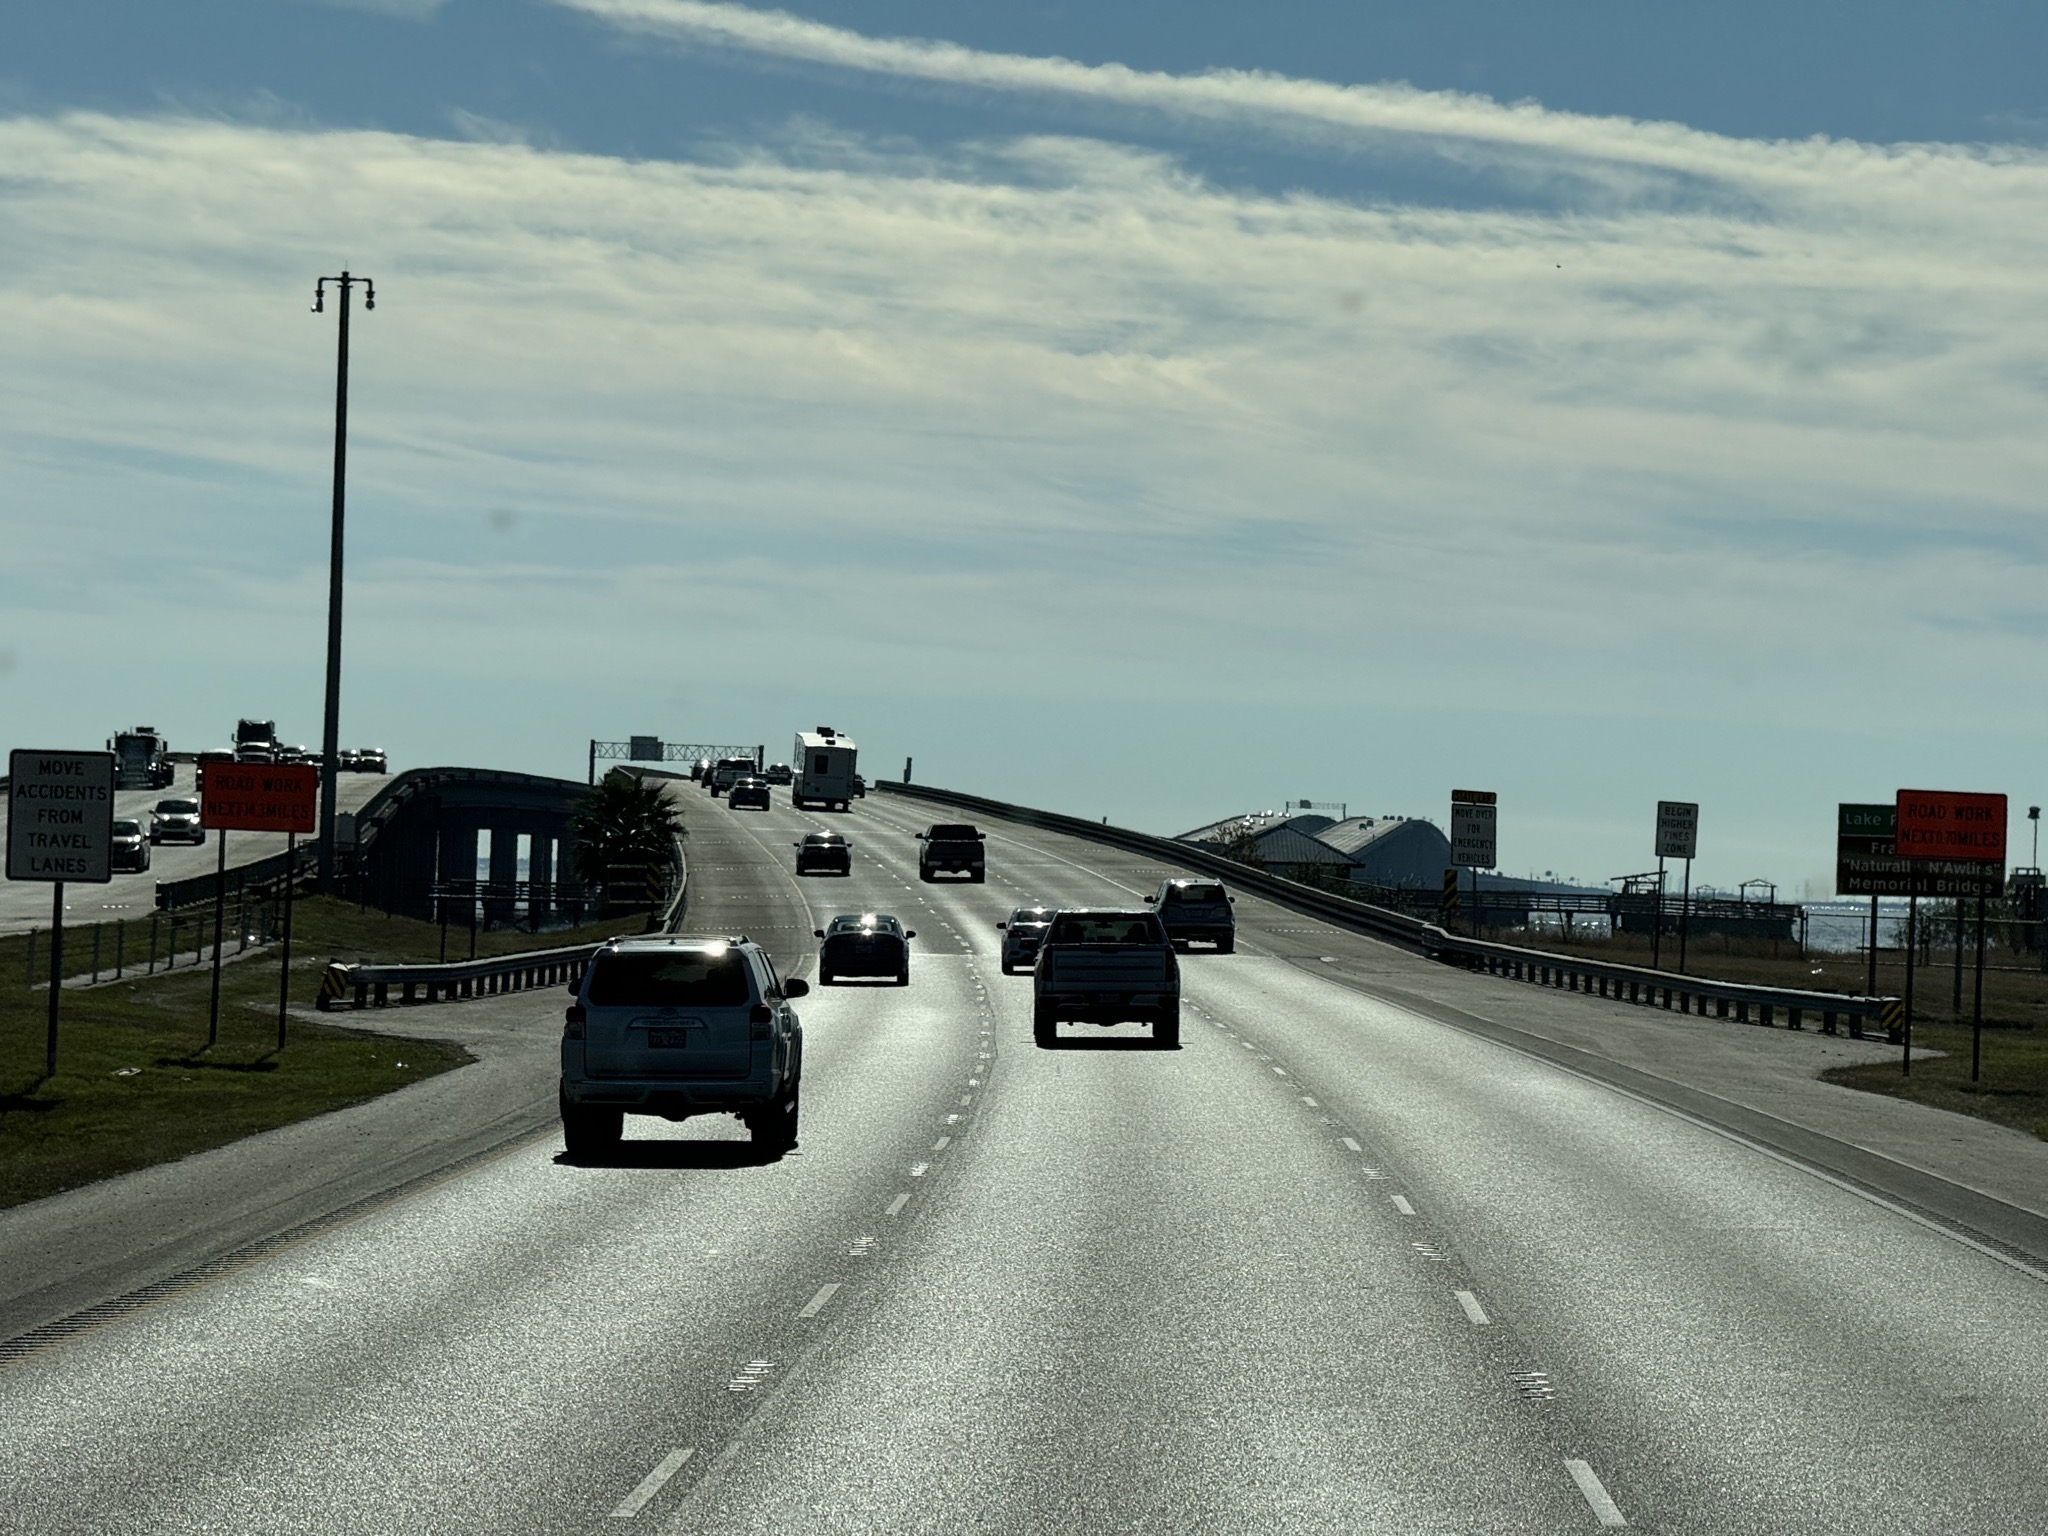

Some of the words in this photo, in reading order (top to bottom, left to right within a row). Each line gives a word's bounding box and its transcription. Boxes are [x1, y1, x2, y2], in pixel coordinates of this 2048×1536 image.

[39, 760, 85, 776] MOVE
[215, 775, 255, 791] ROAD
[262, 777, 303, 793] WORK
[15, 784, 107, 801] ACCIDENTS
[37, 808, 83, 824] FROM
[207, 801, 243, 816] NEXT
[266, 803, 309, 819] MILES
[1455, 808, 1473, 819] MOVE
[1476, 809, 1493, 820] OVER
[1665, 806, 1692, 817] BEGIN
[1908, 803, 1947, 819] ROAD
[1954, 805, 1993, 822] WORK
[1661, 817, 1694, 829] HIGHER
[1845, 812, 1881, 826] Lake
[1467, 824, 1481, 834] FOR
[1664, 831, 1690, 842] FINES
[27, 832, 92, 849] TRAVEL
[1453, 838, 1493, 850] EMERGENCY
[1901, 827, 1935, 844] NEXT
[1958, 831, 2001, 848] MILES
[1664, 843, 1688, 854] ZONE
[1871, 841, 1896, 855] Fra
[30, 856, 87, 873] LANES
[1457, 852, 1490, 865] VEHICLES
[1842, 858, 1920, 874] "Naturall
[1937, 879, 1993, 896] Bridge
